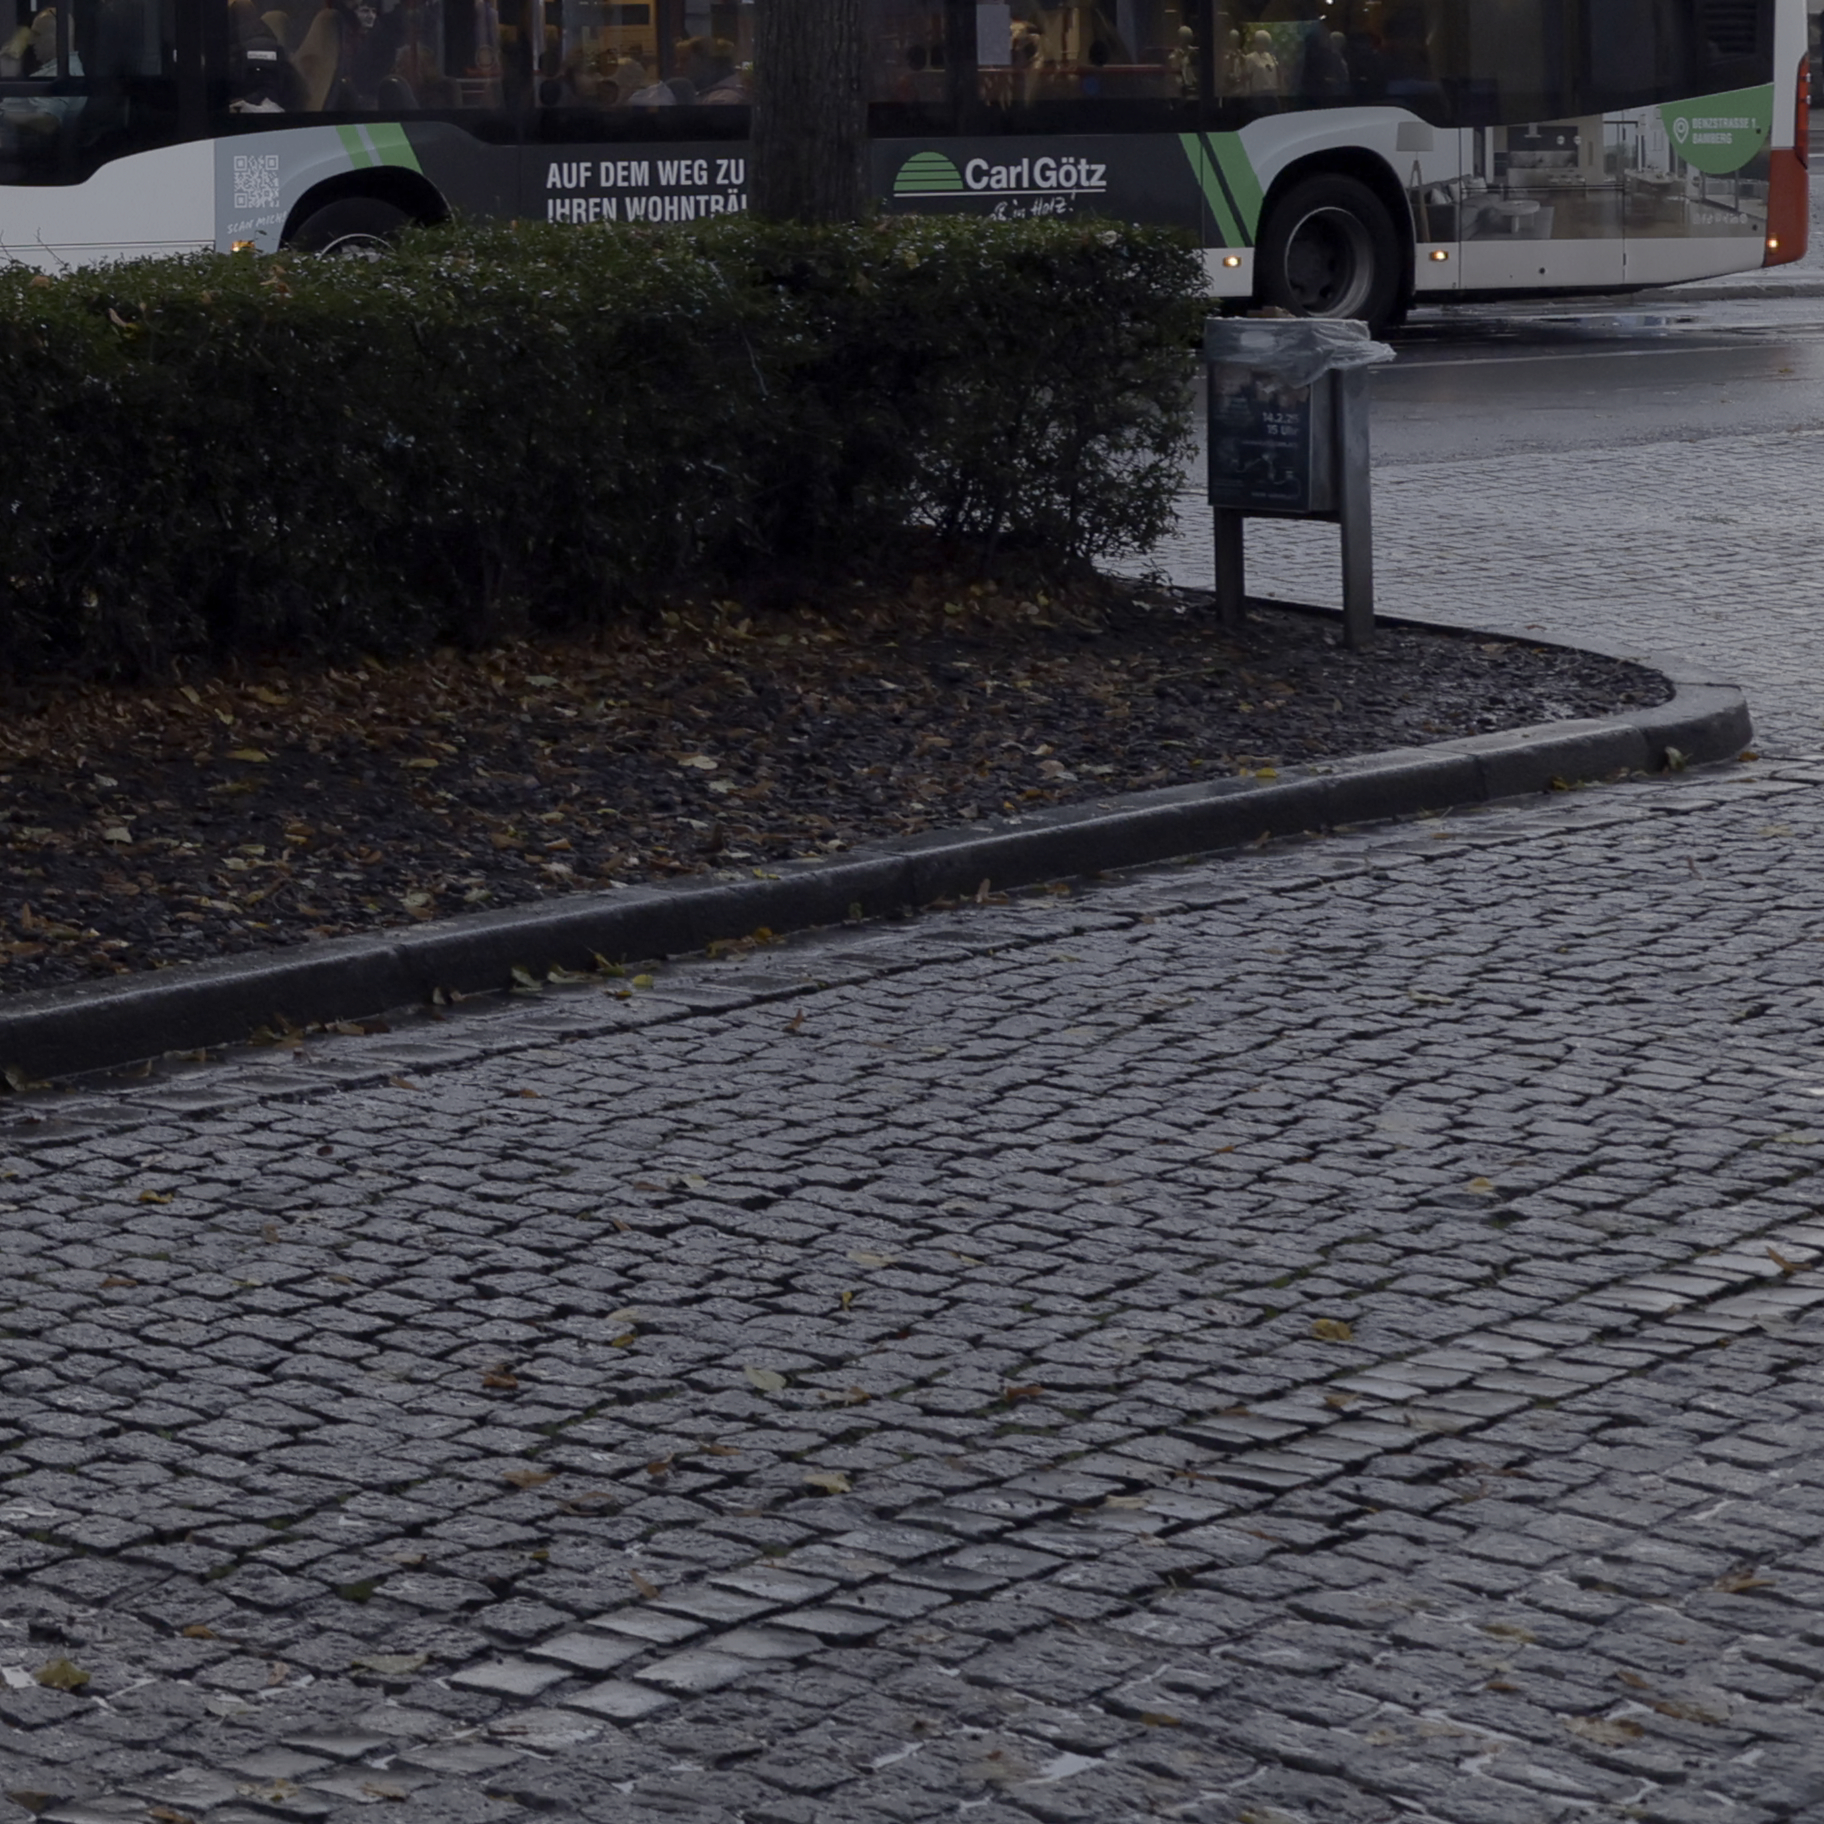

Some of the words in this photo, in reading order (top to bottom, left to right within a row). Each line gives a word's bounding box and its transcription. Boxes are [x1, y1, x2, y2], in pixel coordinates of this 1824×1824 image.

[1692, 117, 1750, 129] BENZSTRASSE
[1692, 132, 1733, 144] BAMBERG
[546, 162, 592, 189] AUF
[600, 161, 650, 187] DEM
[657, 159, 709, 186] WEG
[964, 157, 1029, 190] Carl
[1033, 156, 1107, 189] Götz
[547, 196, 618, 224] IHREN
[226, 219, 255, 235] SCAN
[1267, 424, 1278, 435] 15
